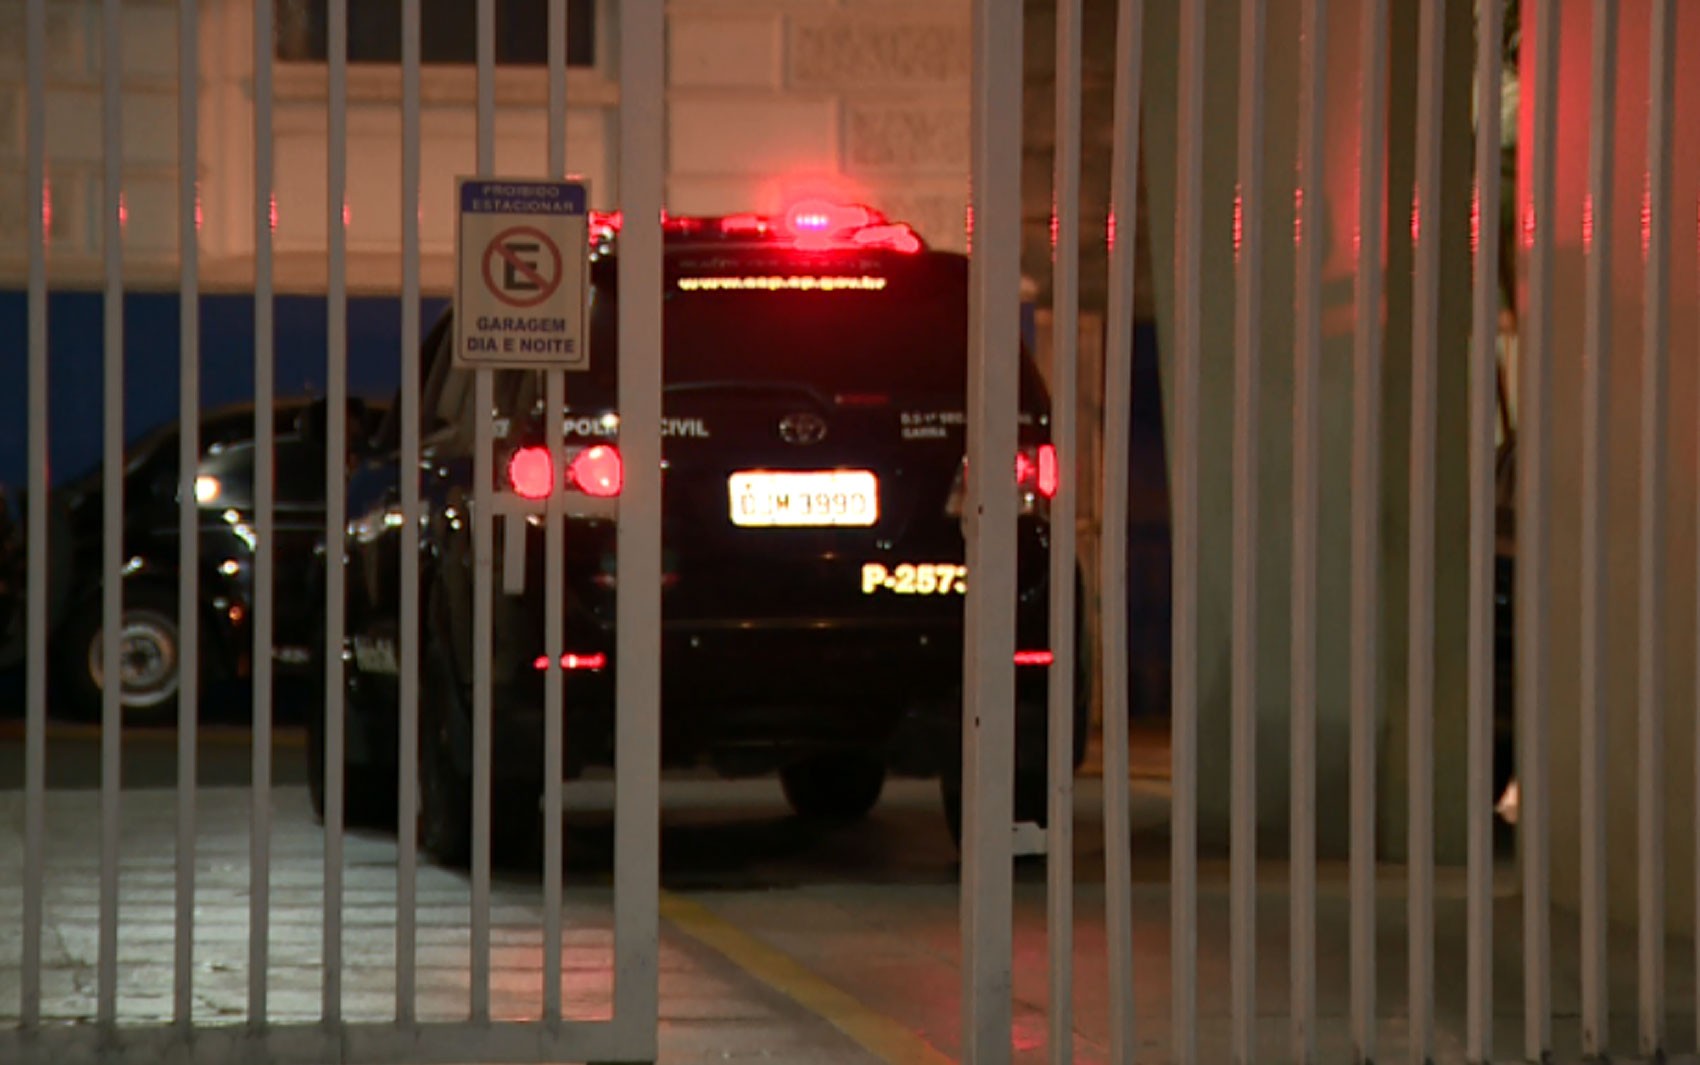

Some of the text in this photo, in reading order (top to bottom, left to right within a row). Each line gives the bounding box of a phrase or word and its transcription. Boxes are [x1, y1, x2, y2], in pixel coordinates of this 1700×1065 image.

[482, 185, 560, 198] PROIBIDO
[472, 200, 574, 212] ESTACIONAR
[476, 316, 566, 332] GARAGEM
[467, 337, 575, 353] DIA E NOITE
